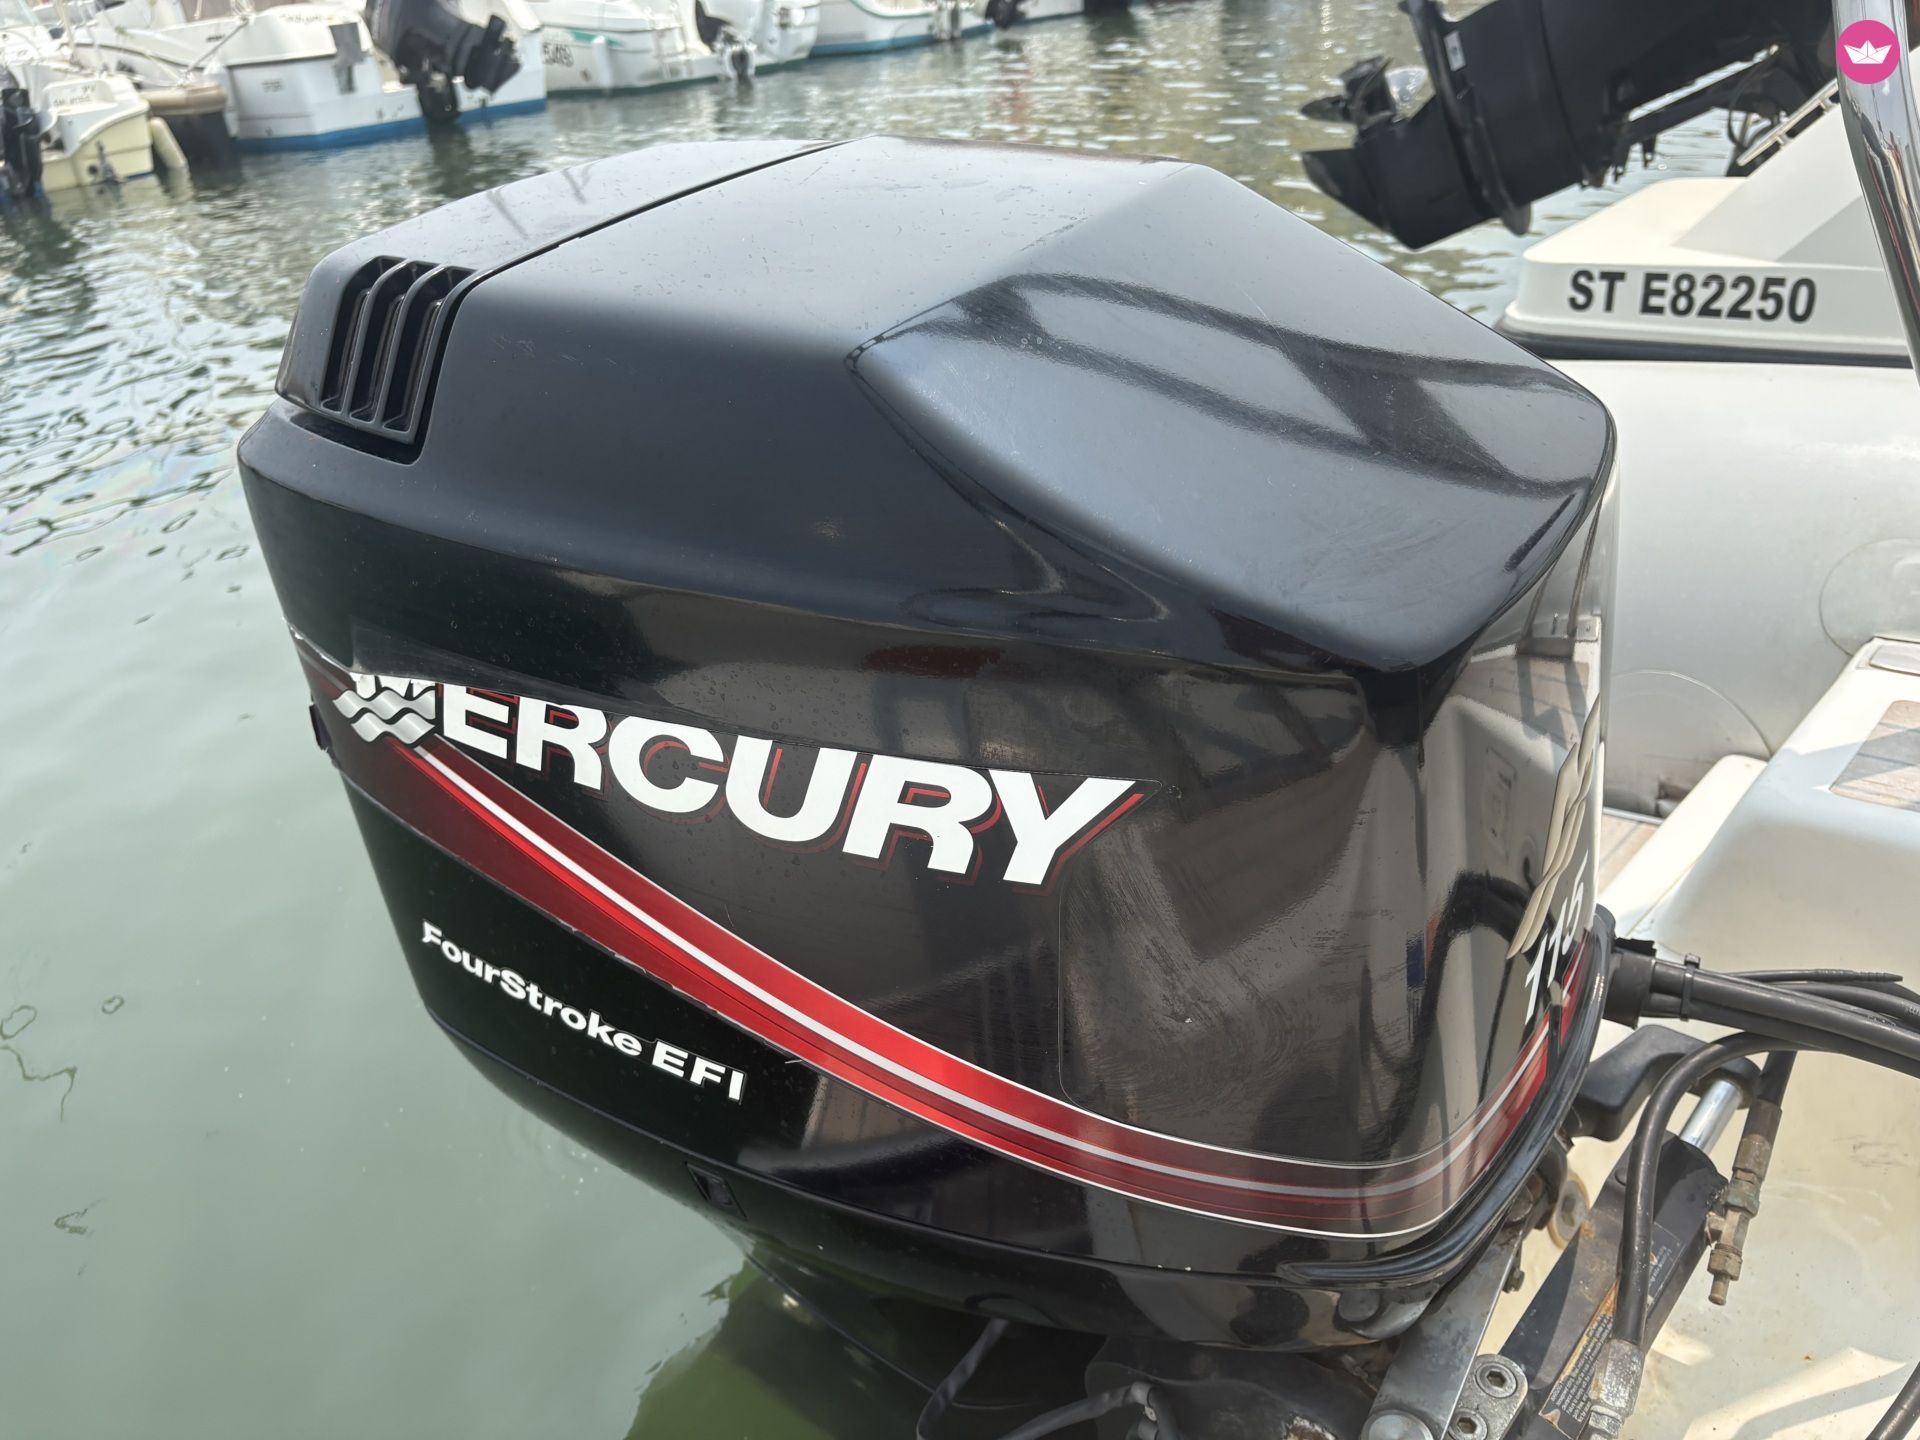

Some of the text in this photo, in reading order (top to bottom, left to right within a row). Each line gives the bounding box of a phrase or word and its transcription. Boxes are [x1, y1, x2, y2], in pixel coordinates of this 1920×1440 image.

[1568, 270, 1817, 323] ST E82250
[334, 672, 1138, 886] MERCURY
[422, 919, 744, 1101] FourStroke EFI
[1524, 848, 1588, 1025] 115
